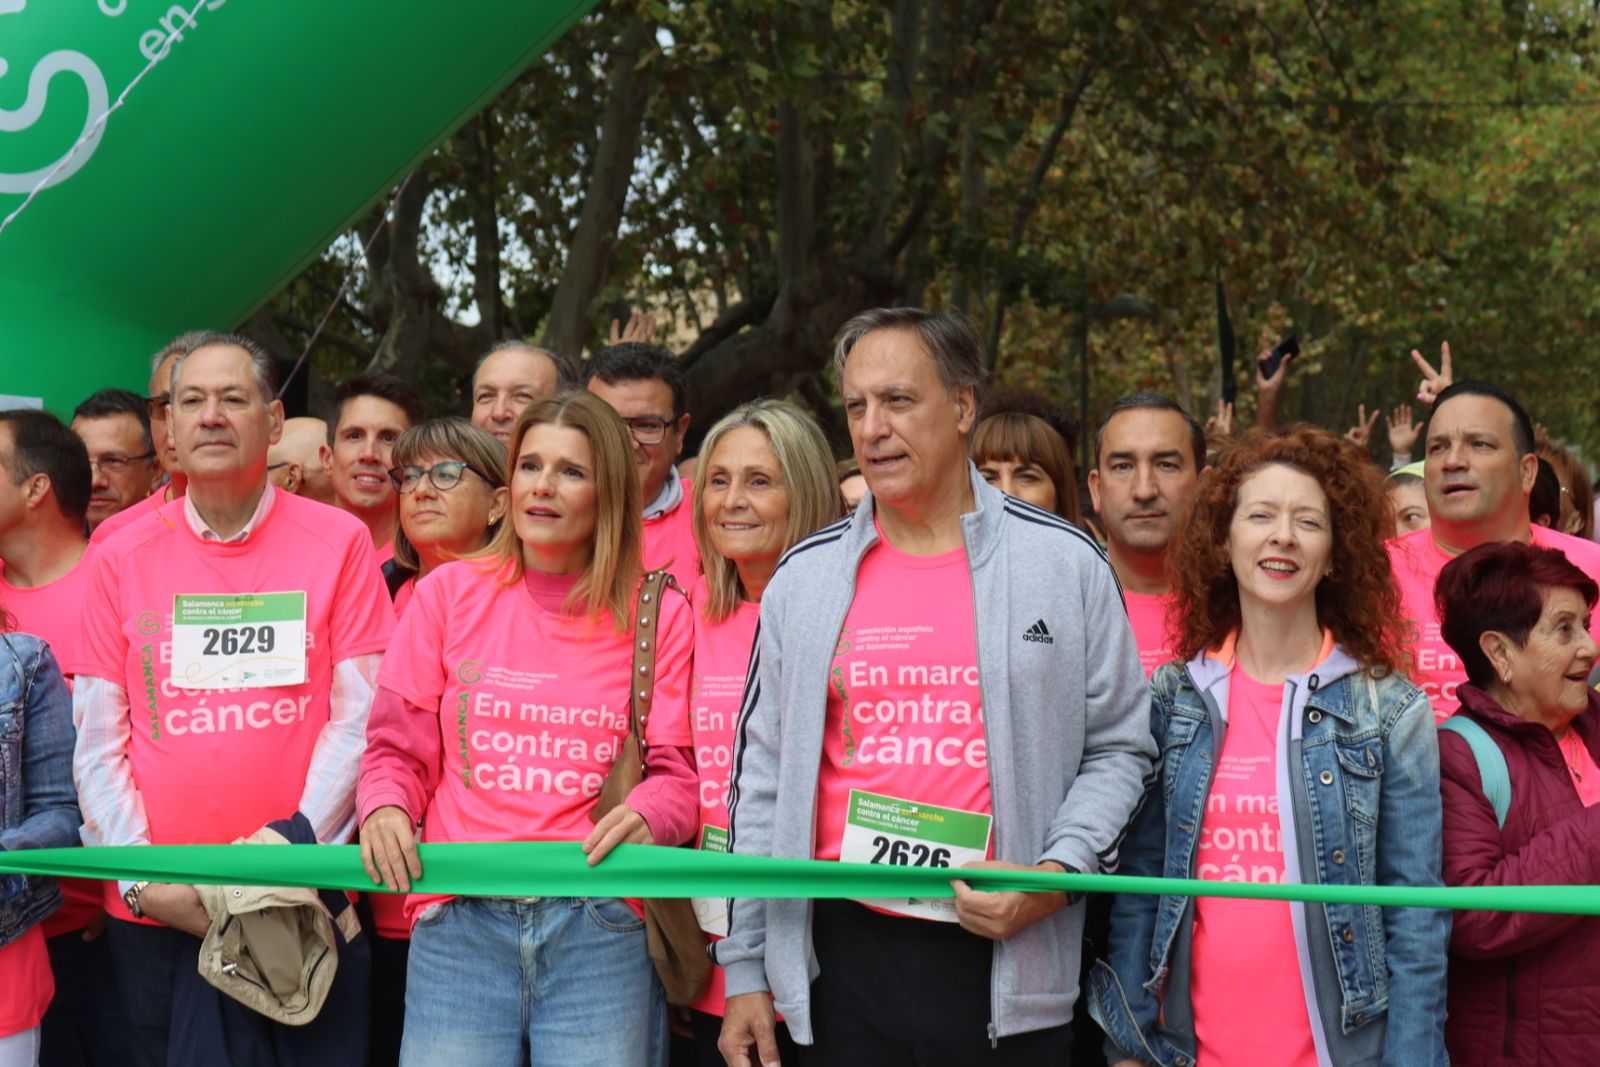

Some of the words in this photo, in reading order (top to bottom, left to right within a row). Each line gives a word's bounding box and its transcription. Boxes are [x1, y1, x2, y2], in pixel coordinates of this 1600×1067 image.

[139, 5, 197, 60] en
[203, 626, 274, 655] 2629
[1022, 633, 1053, 644] adidas
[850, 661, 887, 687] En
[898, 664, 979, 686] marc
[1418, 649, 1456, 670] En
[141, 644, 160, 740] SALAMANCA
[165, 694, 312, 735] cáncer
[474, 692, 511, 718] En
[519, 703, 627, 731] marcha
[697, 707, 723, 731] En
[832, 665, 855, 766] SALANCA
[853, 694, 972, 724] contra
[456, 692, 472, 789] SALAMANCA
[471, 730, 588, 761] contra
[593, 736, 618, 764] el
[856, 726, 987, 768] cánce
[474, 755, 604, 797] cánce
[857, 797, 900, 814] Salamanca
[857, 807, 880, 819] contra
[882, 812, 891, 821] el
[891, 813, 919, 826] cáncer
[1208, 793, 1226, 813] n
[1199, 822, 1283, 852] cont
[870, 836, 951, 869] 2626
[1198, 854, 1287, 884] cán
